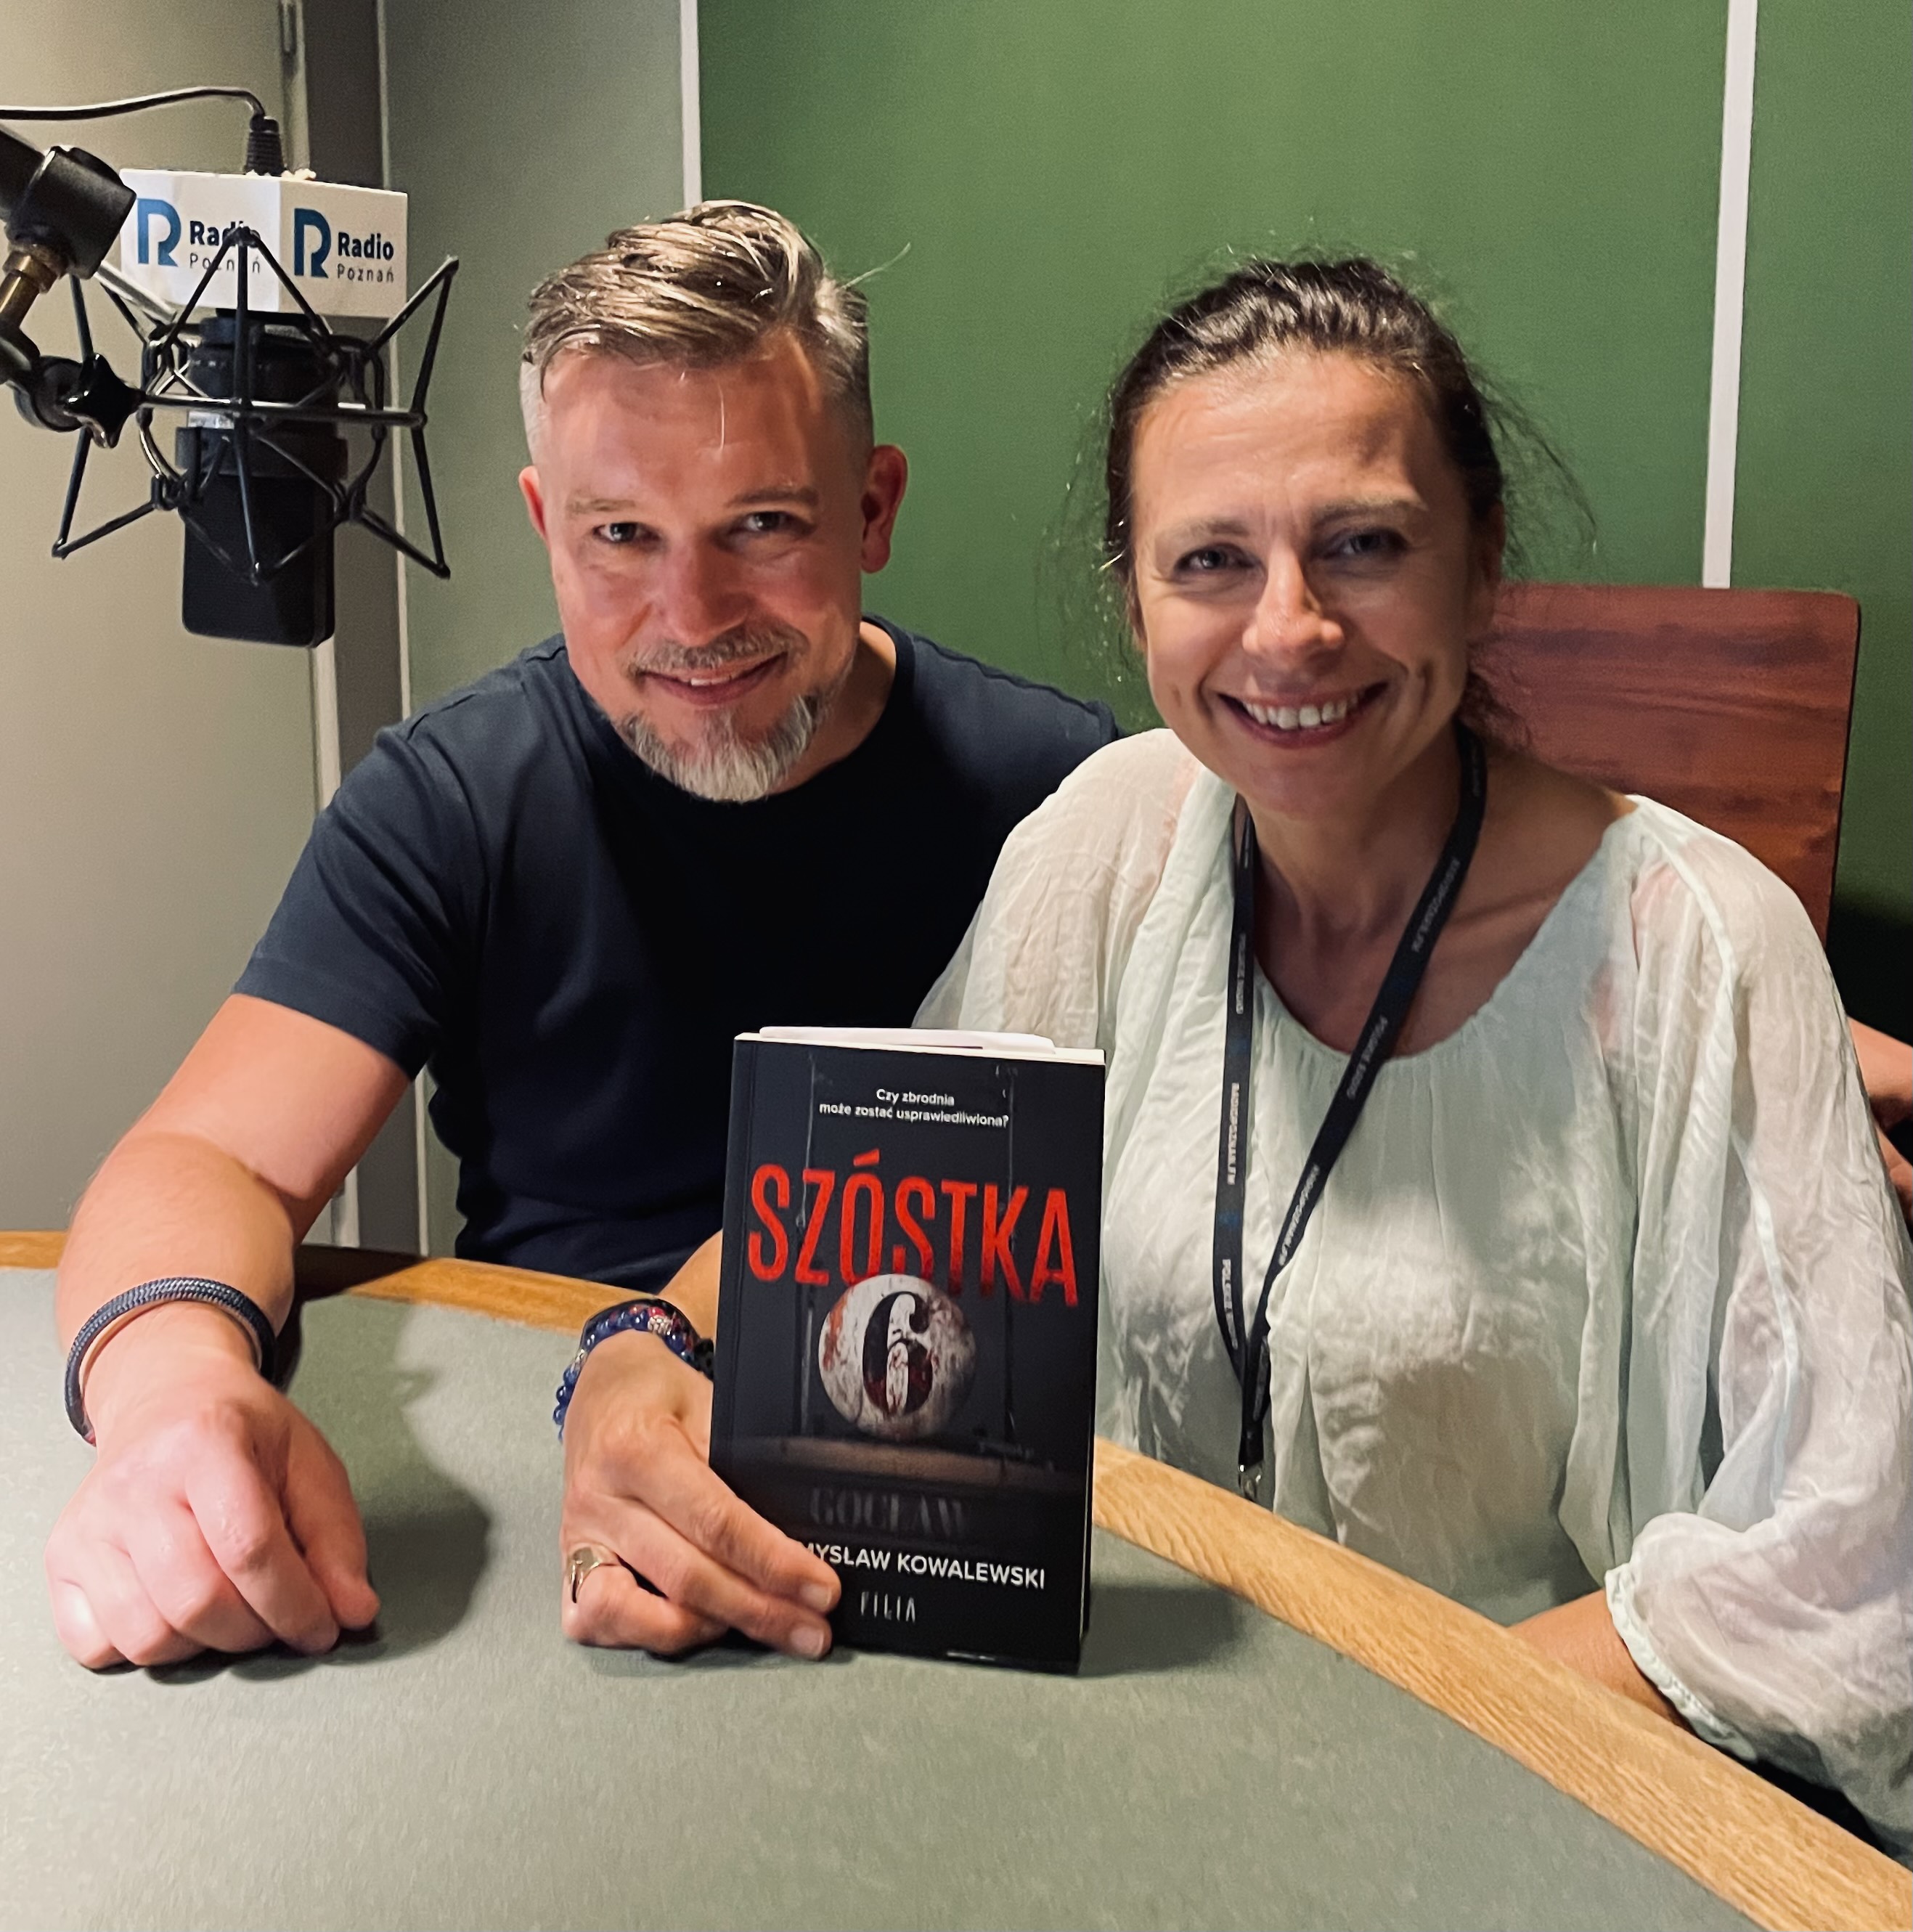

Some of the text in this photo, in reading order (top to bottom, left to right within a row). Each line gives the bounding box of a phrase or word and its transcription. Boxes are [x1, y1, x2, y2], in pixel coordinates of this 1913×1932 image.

[293, 208, 331, 279] R
[338, 232, 393, 261] Radio
[189, 253, 260, 274] Ponń
[337, 263, 393, 282] Poznań
[876, 1088, 955, 1106] Czy zbrodnia
[819, 1103, 1009, 1128] może zostać usprawiedliwiona?
[747, 1148, 1079, 1307] SZÓSTKA
[862, 1291, 934, 1417] 6
[897, 1552, 1045, 1590] KOWALEWSKI
